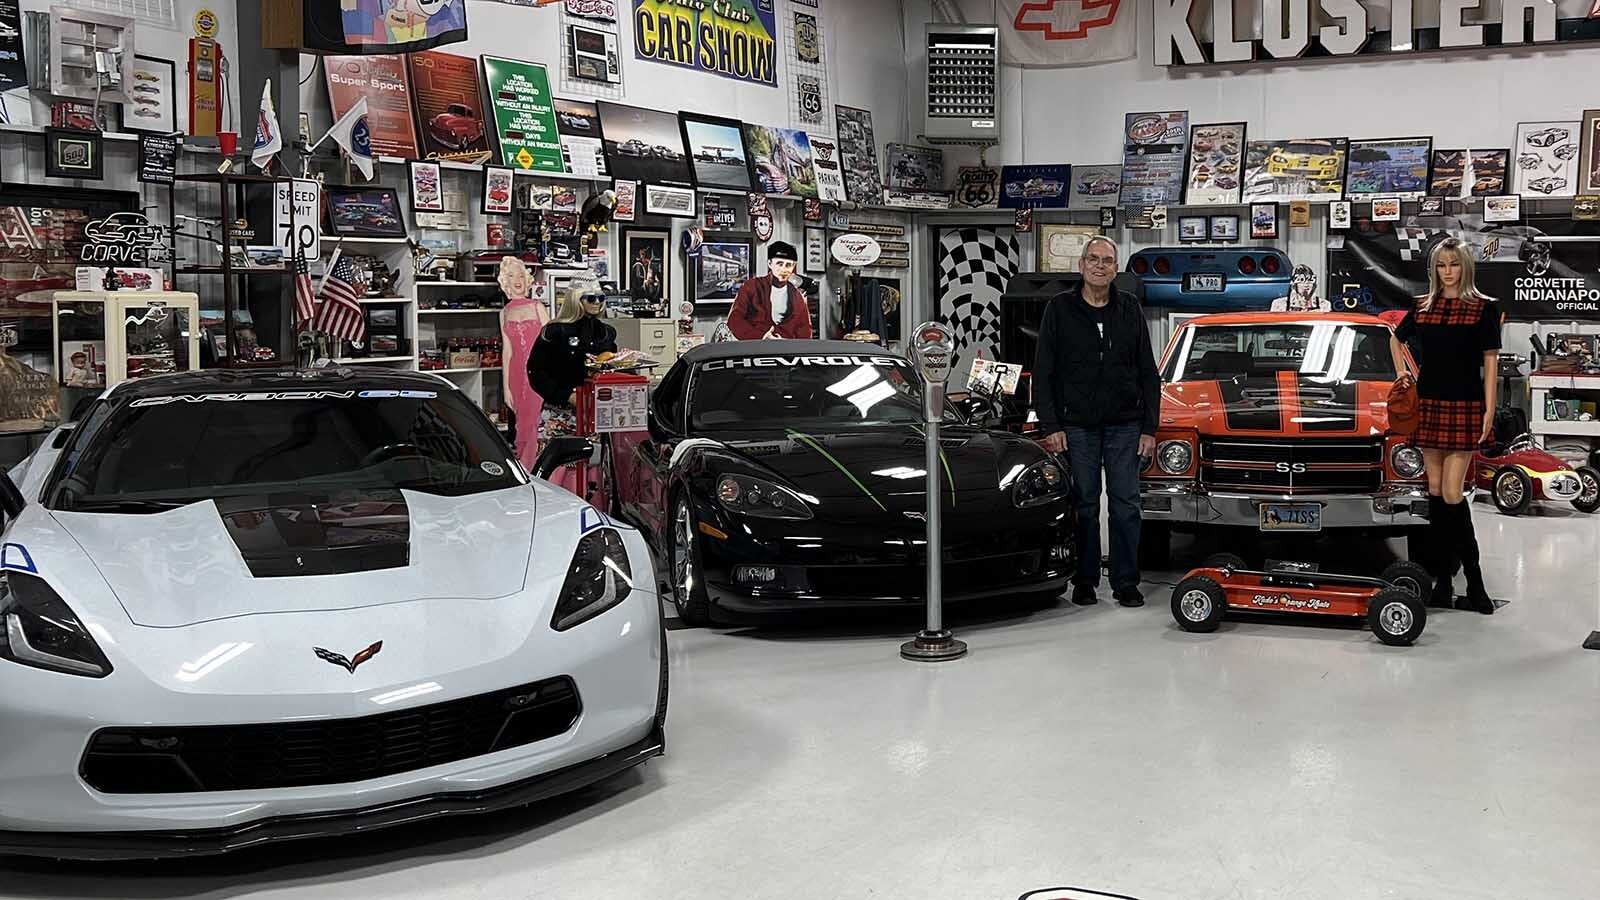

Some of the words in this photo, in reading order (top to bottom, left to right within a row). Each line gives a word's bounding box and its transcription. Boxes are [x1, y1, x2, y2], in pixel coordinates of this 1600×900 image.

[636, 7, 695, 66] CAR
[698, 20, 775, 83] SHOW
[331, 74, 367, 86] Super
[371, 79, 405, 92] Sport
[506, 79, 533, 88] LOCATION
[515, 86, 539, 95] WORKED
[496, 100, 521, 109] WITHOUT
[531, 104, 551, 113] INJURY
[804, 93, 820, 112] 66
[513, 117, 541, 125] LOCATION
[522, 124, 546, 132] WORKED
[500, 138, 526, 147] WITHOUT
[536, 141, 561, 149] INCIDENT
[817, 172, 841, 187] PARKING
[279, 189, 315, 202] SPEED
[966, 185, 990, 203] 66
[282, 206, 312, 217] LMIT
[279, 223, 315, 248] 70
[1482, 237, 1500, 261] 500
[1293, 273, 1316, 284] 2025
[1514, 277, 1585, 289] CORVETTE
[1514, 288, 1600, 301] INDIANAPO
[1556, 302, 1599, 311] OFFICIAL
[701, 355, 914, 373] CHEVROLET
[1276, 462, 1306, 473] SS
